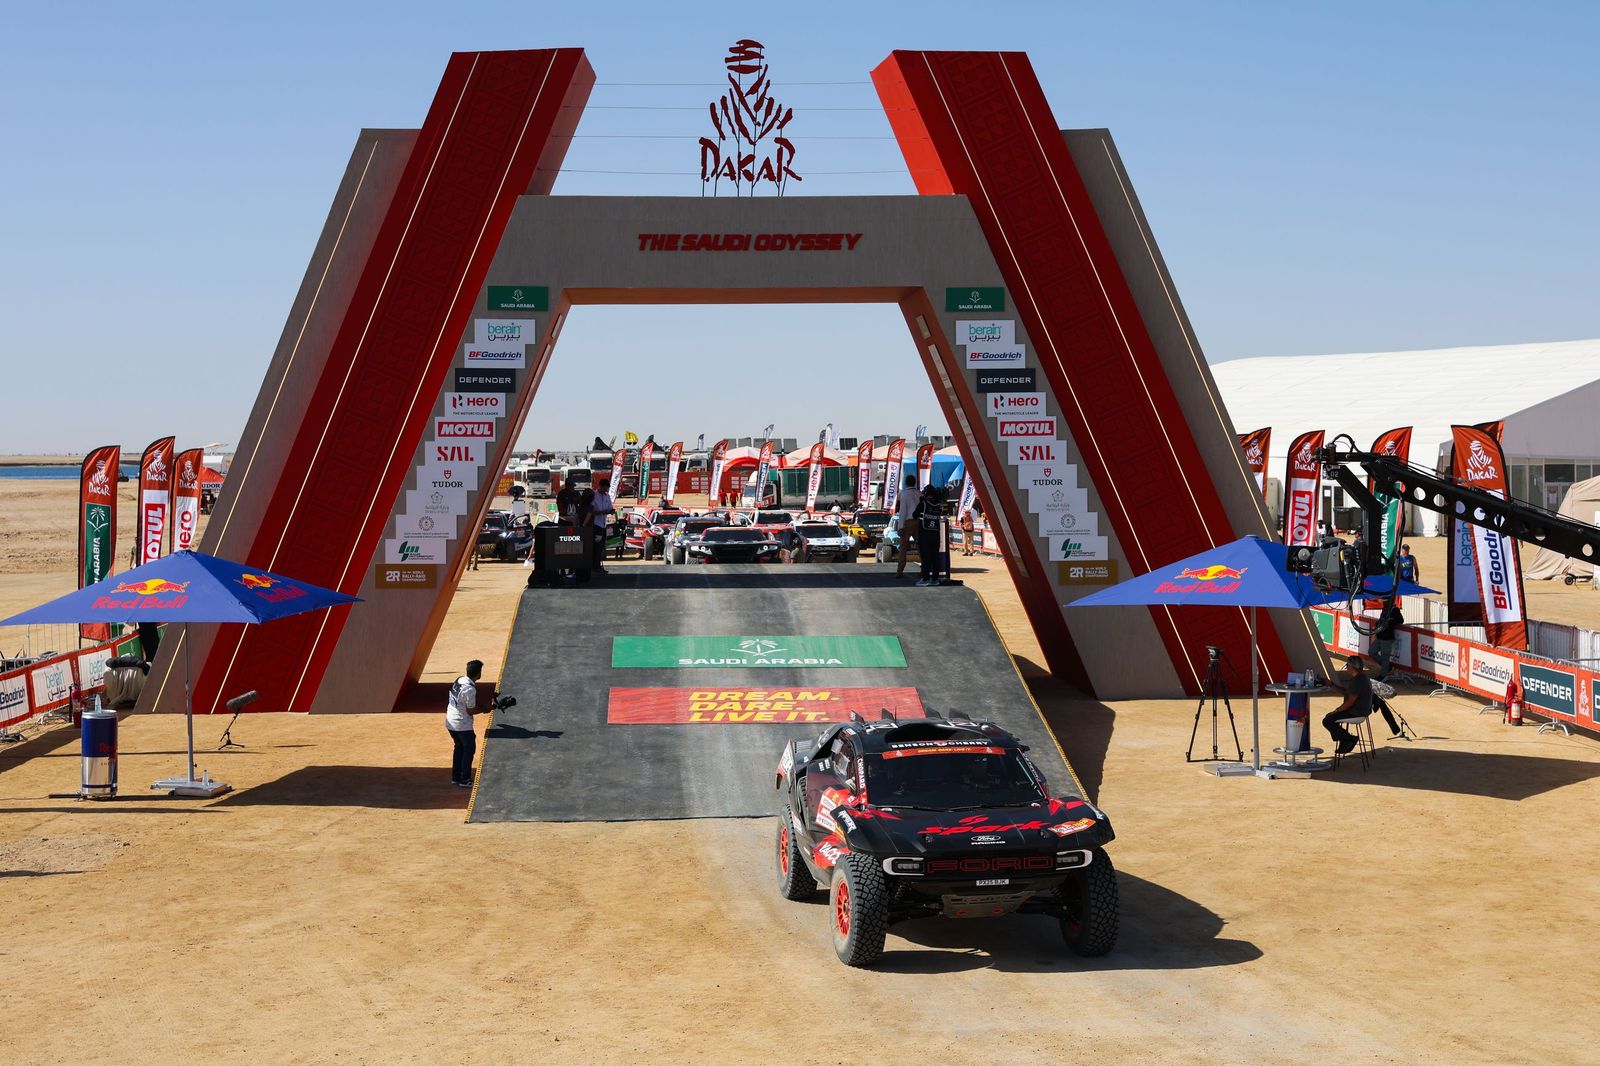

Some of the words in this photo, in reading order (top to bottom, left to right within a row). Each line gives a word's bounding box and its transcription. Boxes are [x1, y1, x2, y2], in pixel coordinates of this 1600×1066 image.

[699, 137, 801, 182] DAKAR
[639, 234, 681, 251] THE
[682, 234, 752, 251] SAUDI
[753, 233, 863, 251] ODYSSEY
[488, 322, 520, 334] berain
[969, 323, 1001, 334] berain
[468, 351, 522, 359] BFGoodrich
[459, 376, 512, 384] DEFENDER
[440, 423, 491, 435] MOTUL
[1002, 423, 1052, 435] MOTUL
[1294, 461, 1316, 472] DAKAR
[146, 470, 168, 482] DAKAR
[1466, 467, 1499, 481] DAKAR
[88, 483, 111, 497] DAKAR
[179, 478, 199, 490] DAKAR
[888, 472, 897, 499] TUDOR
[93, 537, 101, 575] ARABIA
[1483, 529, 1507, 609] BFGoodr
[1153, 582, 1200, 593] Red
[1197, 581, 1243, 593] Bull
[92, 596, 137, 609] Red
[137, 595, 189, 608] Bull
[1420, 643, 1455, 664] BFGoodrich
[1472, 658, 1510, 680] BFGoodrich
[0, 687, 25, 704] Goodrich
[1522, 676, 1573, 702] DEFENDER
[688, 691, 841, 701] DREAM.
[688, 701, 805, 711] DARE.
[688, 711, 778, 722] LIVE
[785, 711, 830, 721] IT.
[928, 857, 1054, 874] FORD
